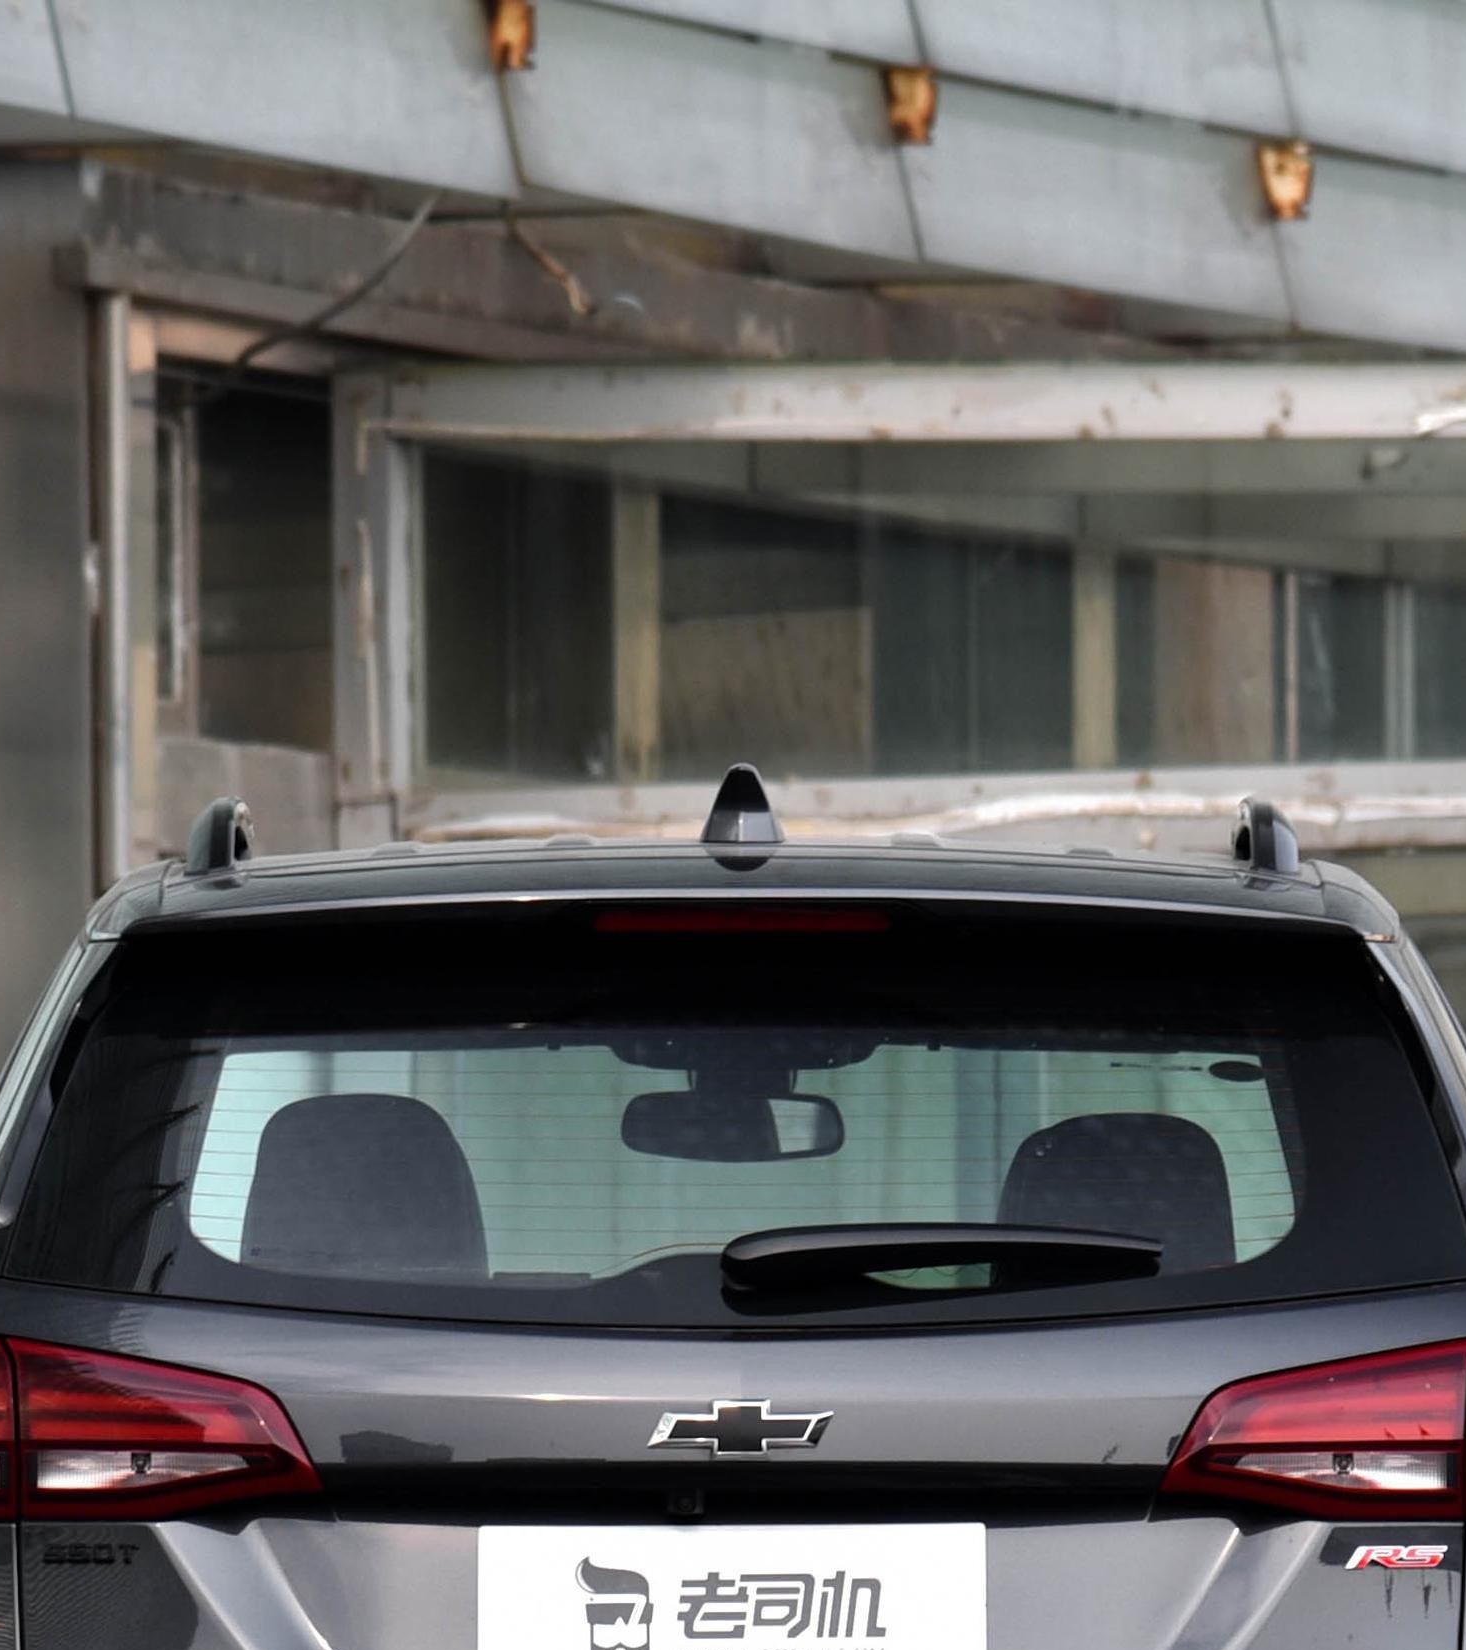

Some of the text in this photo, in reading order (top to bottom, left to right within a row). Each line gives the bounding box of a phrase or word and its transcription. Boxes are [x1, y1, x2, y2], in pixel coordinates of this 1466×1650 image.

[1344, 1545, 1448, 1570] RS
[676, 1570, 886, 1640] 老司机
